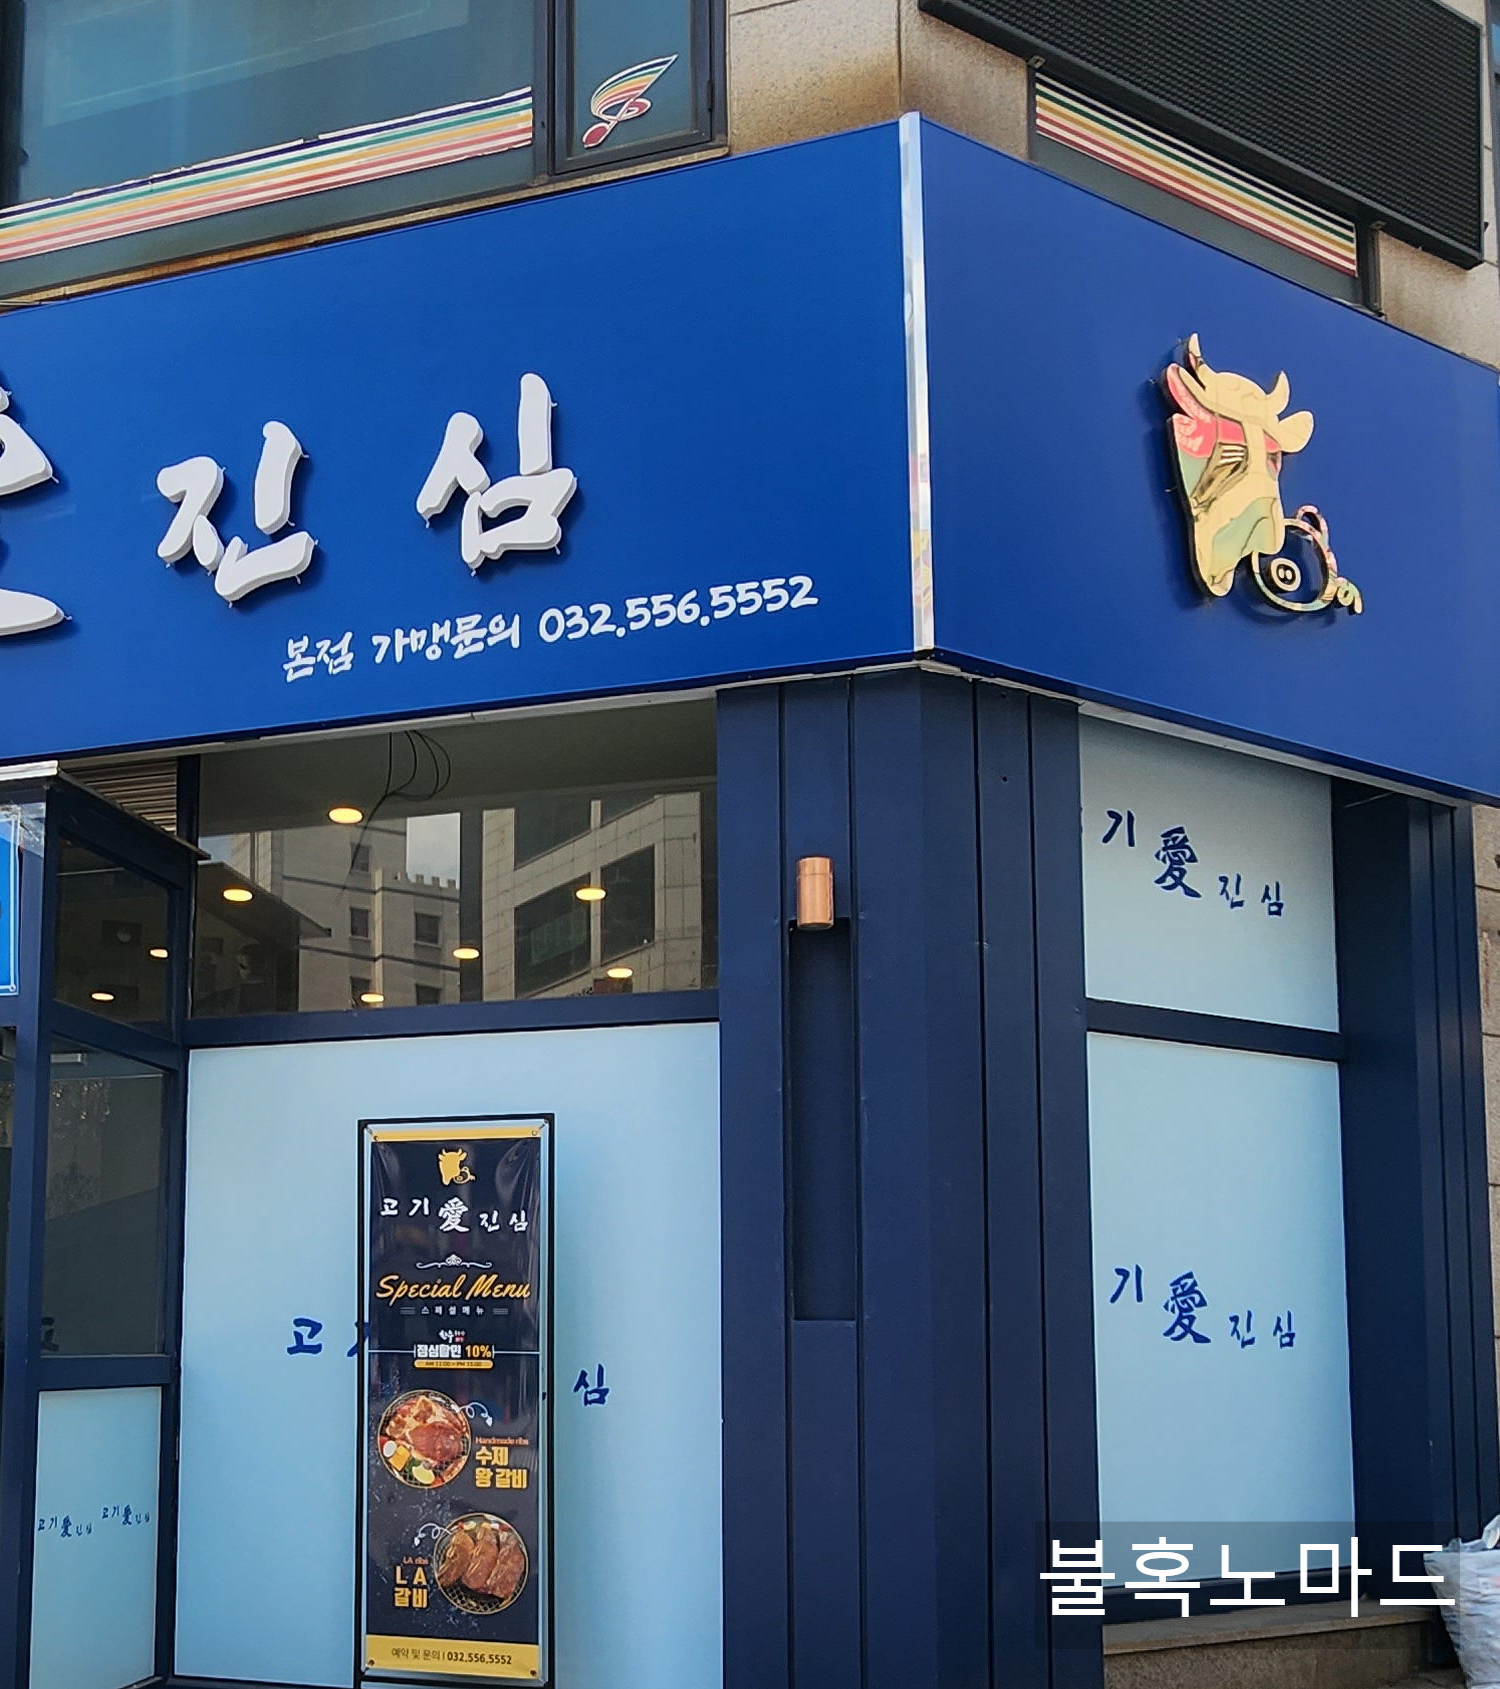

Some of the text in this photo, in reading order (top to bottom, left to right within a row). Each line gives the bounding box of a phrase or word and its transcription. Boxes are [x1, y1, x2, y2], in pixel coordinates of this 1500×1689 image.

[282, 574, 818, 682] 본점 가맹문의 032.556.5552
[376, 1274, 531, 1306] Special Menu
[465, 1344, 491, 1358] 10%
[475, 1446, 509, 1466] 수제
[394, 1587, 428, 1609] 갈비
[391, 1647, 512, 1665] 예약 및 문의 032.556.5552
